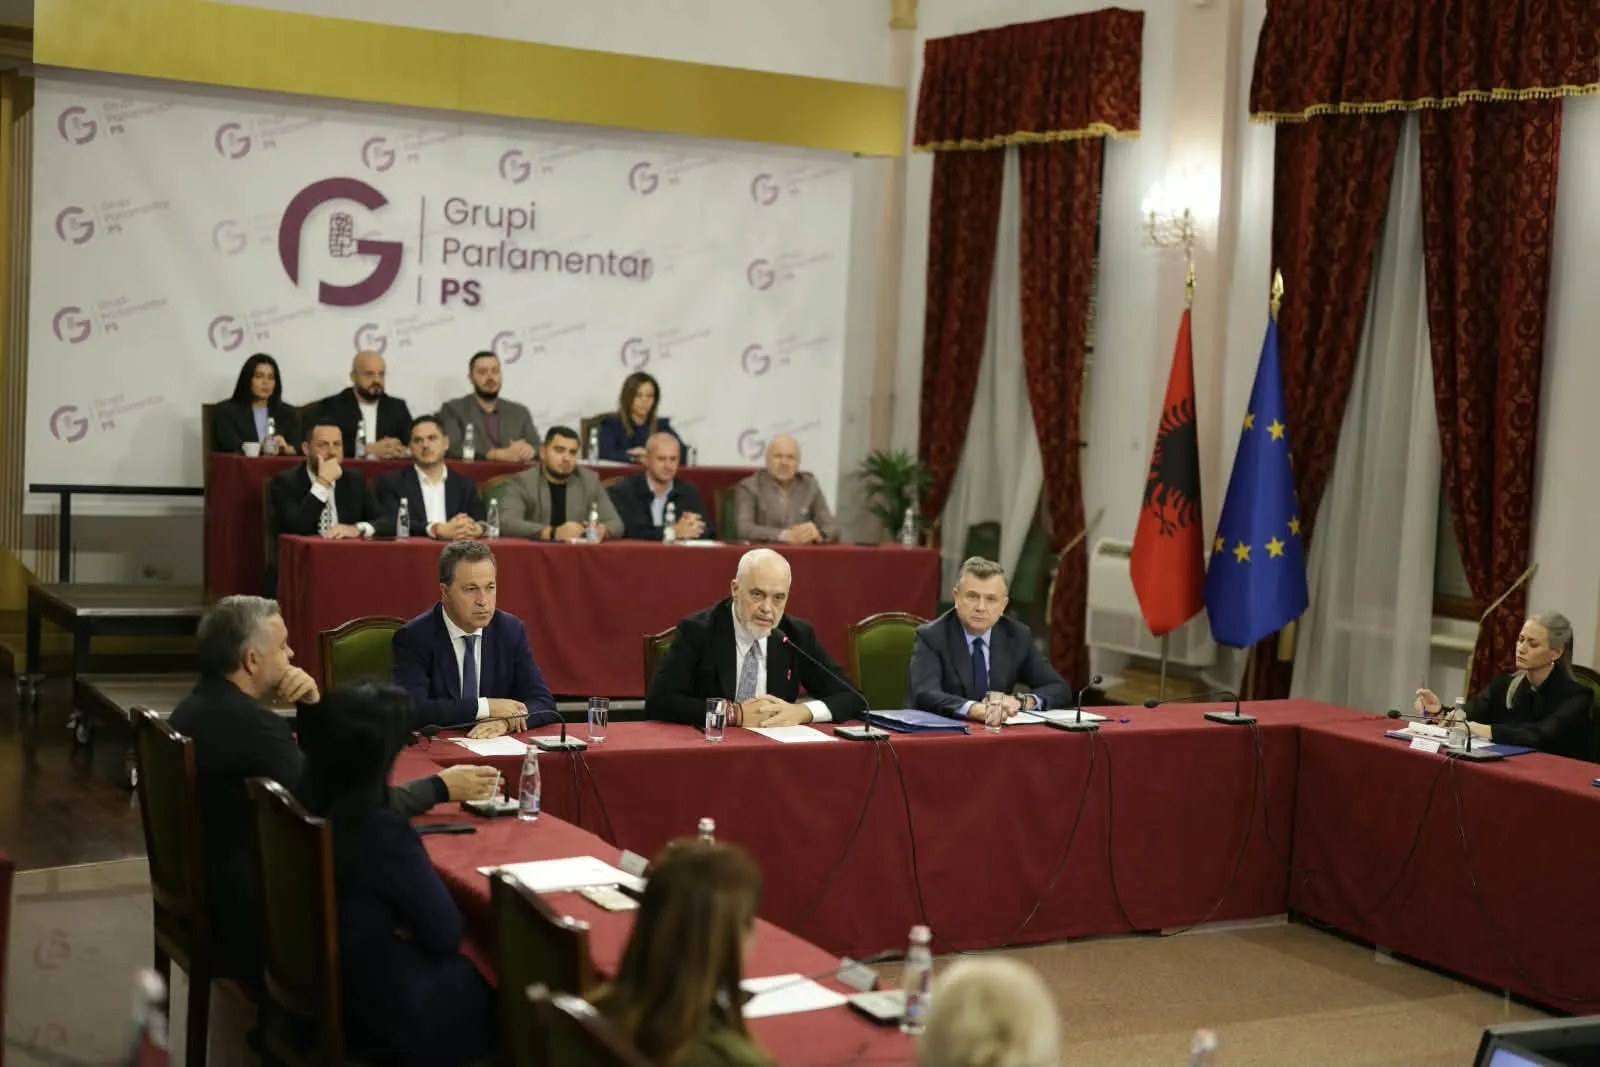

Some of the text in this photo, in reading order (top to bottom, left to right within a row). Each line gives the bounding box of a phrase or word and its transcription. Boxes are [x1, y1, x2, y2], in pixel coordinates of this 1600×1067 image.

[444, 197, 536, 239] Grupi
[441, 236, 653, 281] Parlamentar
[439, 277, 482, 307] PS
